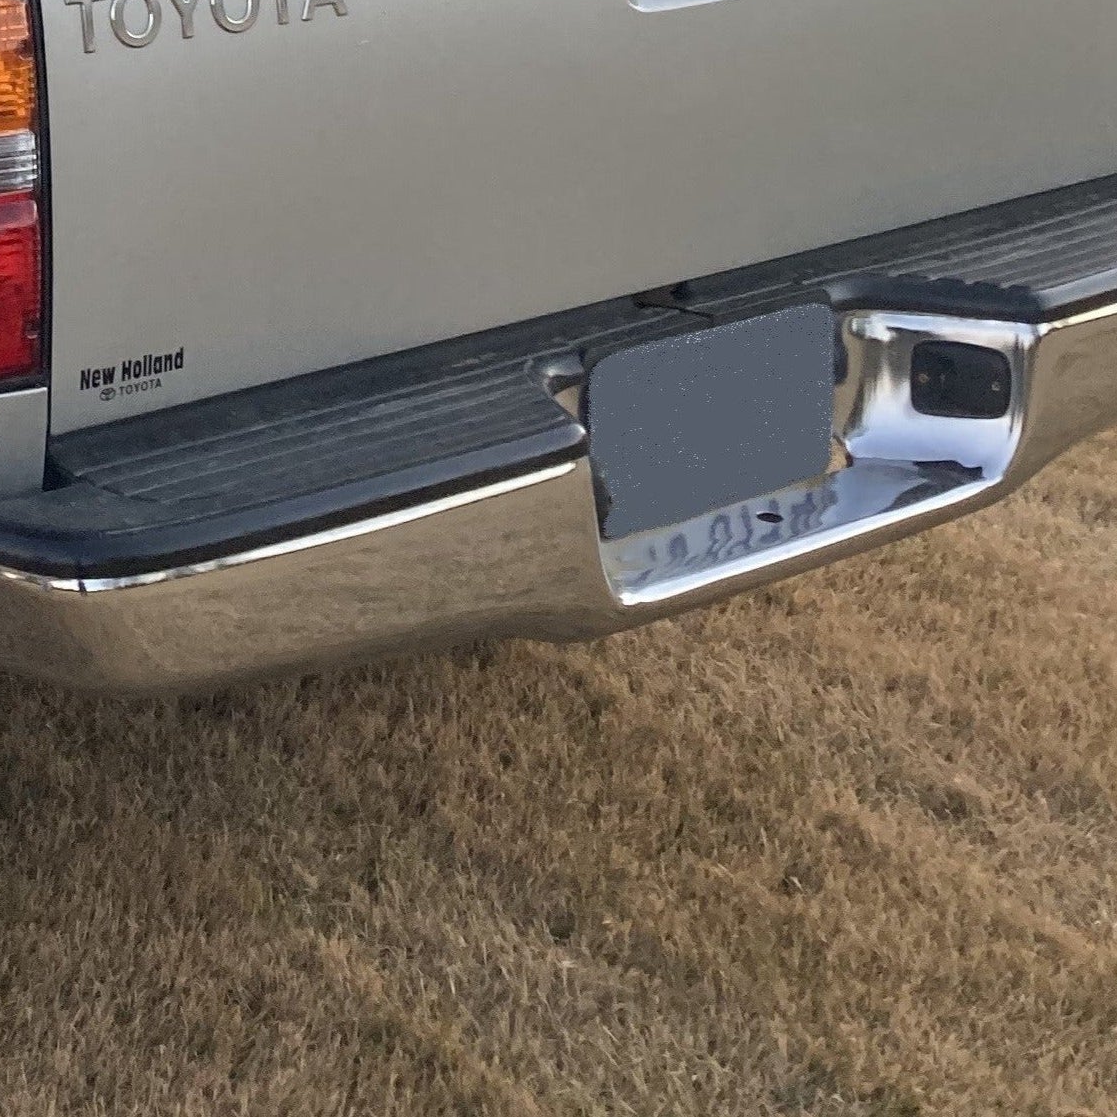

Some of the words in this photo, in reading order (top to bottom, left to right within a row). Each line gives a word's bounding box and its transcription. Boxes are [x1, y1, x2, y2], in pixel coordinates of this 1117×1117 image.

[80, 366, 116, 390] New
[121, 346, 184, 381] Holland
[119, 377, 162, 396] TOYOTA
